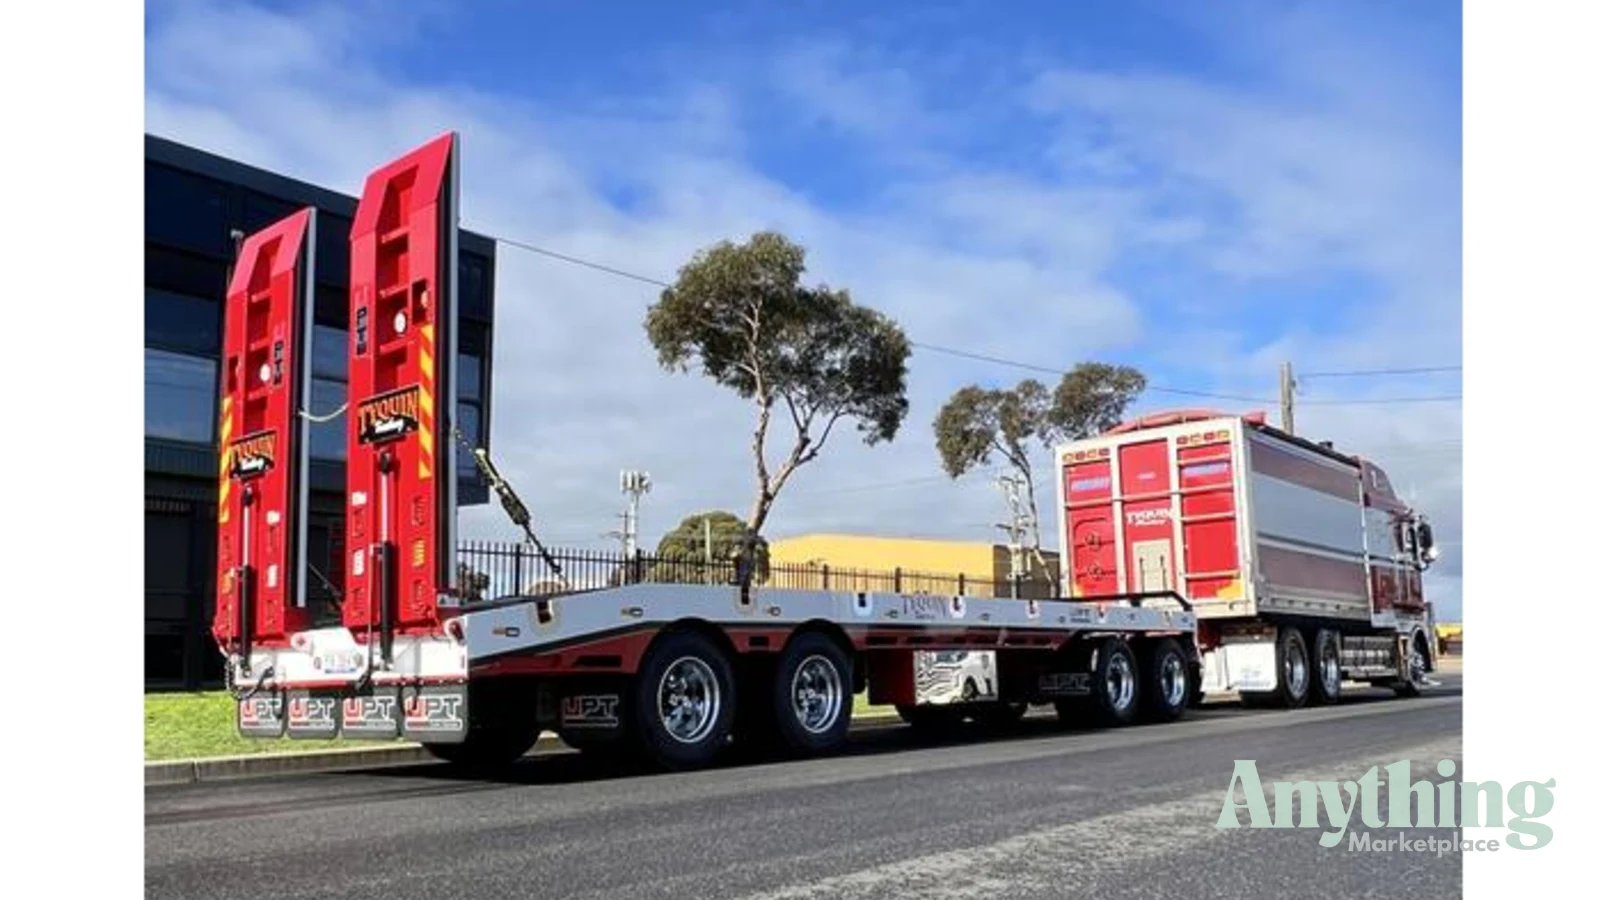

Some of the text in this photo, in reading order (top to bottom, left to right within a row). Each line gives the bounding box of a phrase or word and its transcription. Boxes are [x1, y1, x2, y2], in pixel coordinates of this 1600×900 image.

[359, 391, 419, 435] TYQUIN
[241, 699, 281, 719] UPT
[290, 698, 334, 719] UPT
[344, 697, 395, 720] UPT
[404, 695, 461, 719] UPT
[563, 696, 619, 718] UPT
